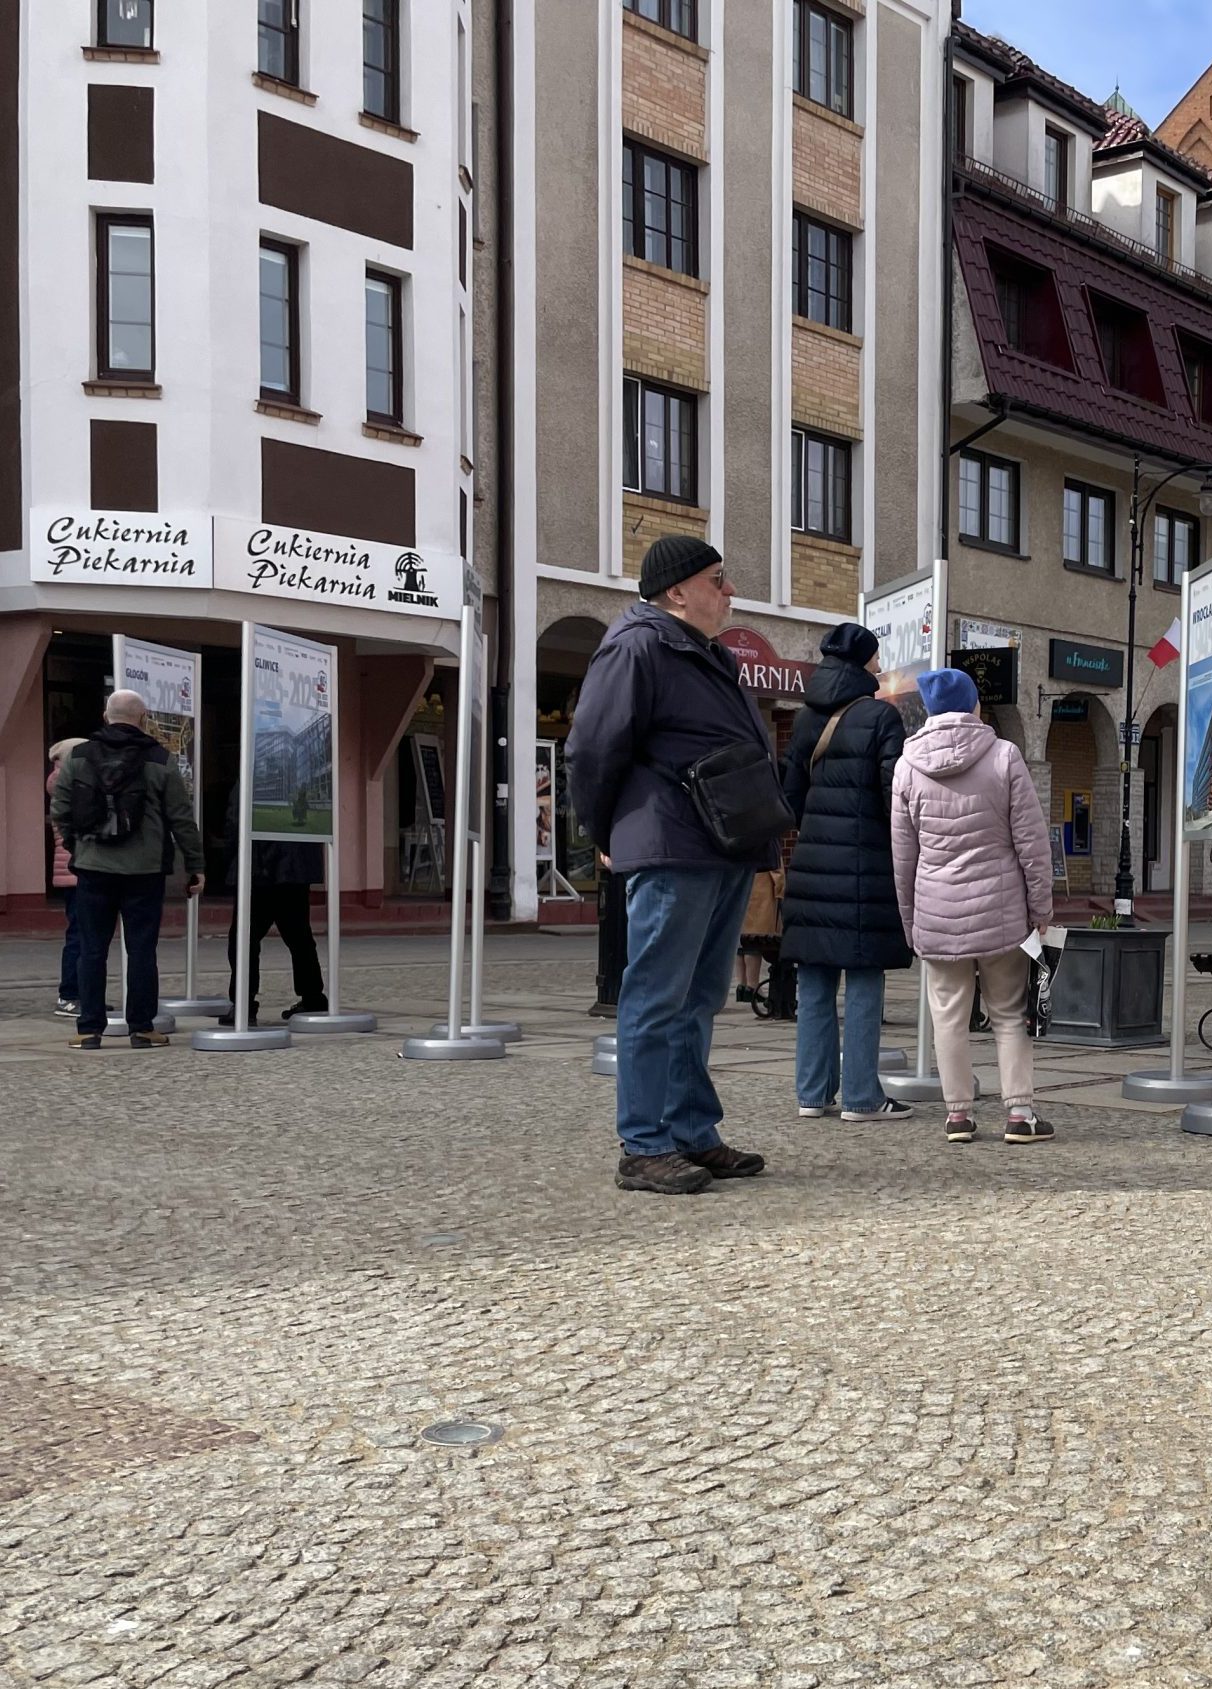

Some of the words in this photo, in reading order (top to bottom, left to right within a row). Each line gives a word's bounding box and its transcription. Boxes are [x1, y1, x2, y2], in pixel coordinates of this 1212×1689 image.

[47, 517, 189, 546] Cukiernia
[47, 545, 196, 576] Piekarnia
[247, 529, 371, 569] Cukiernia
[247, 559, 377, 600] Piekarnia
[387, 590, 440, 608] MIELNIK
[255, 657, 279, 673] GLIWICE
[738, 662, 805, 693] ARNIA
